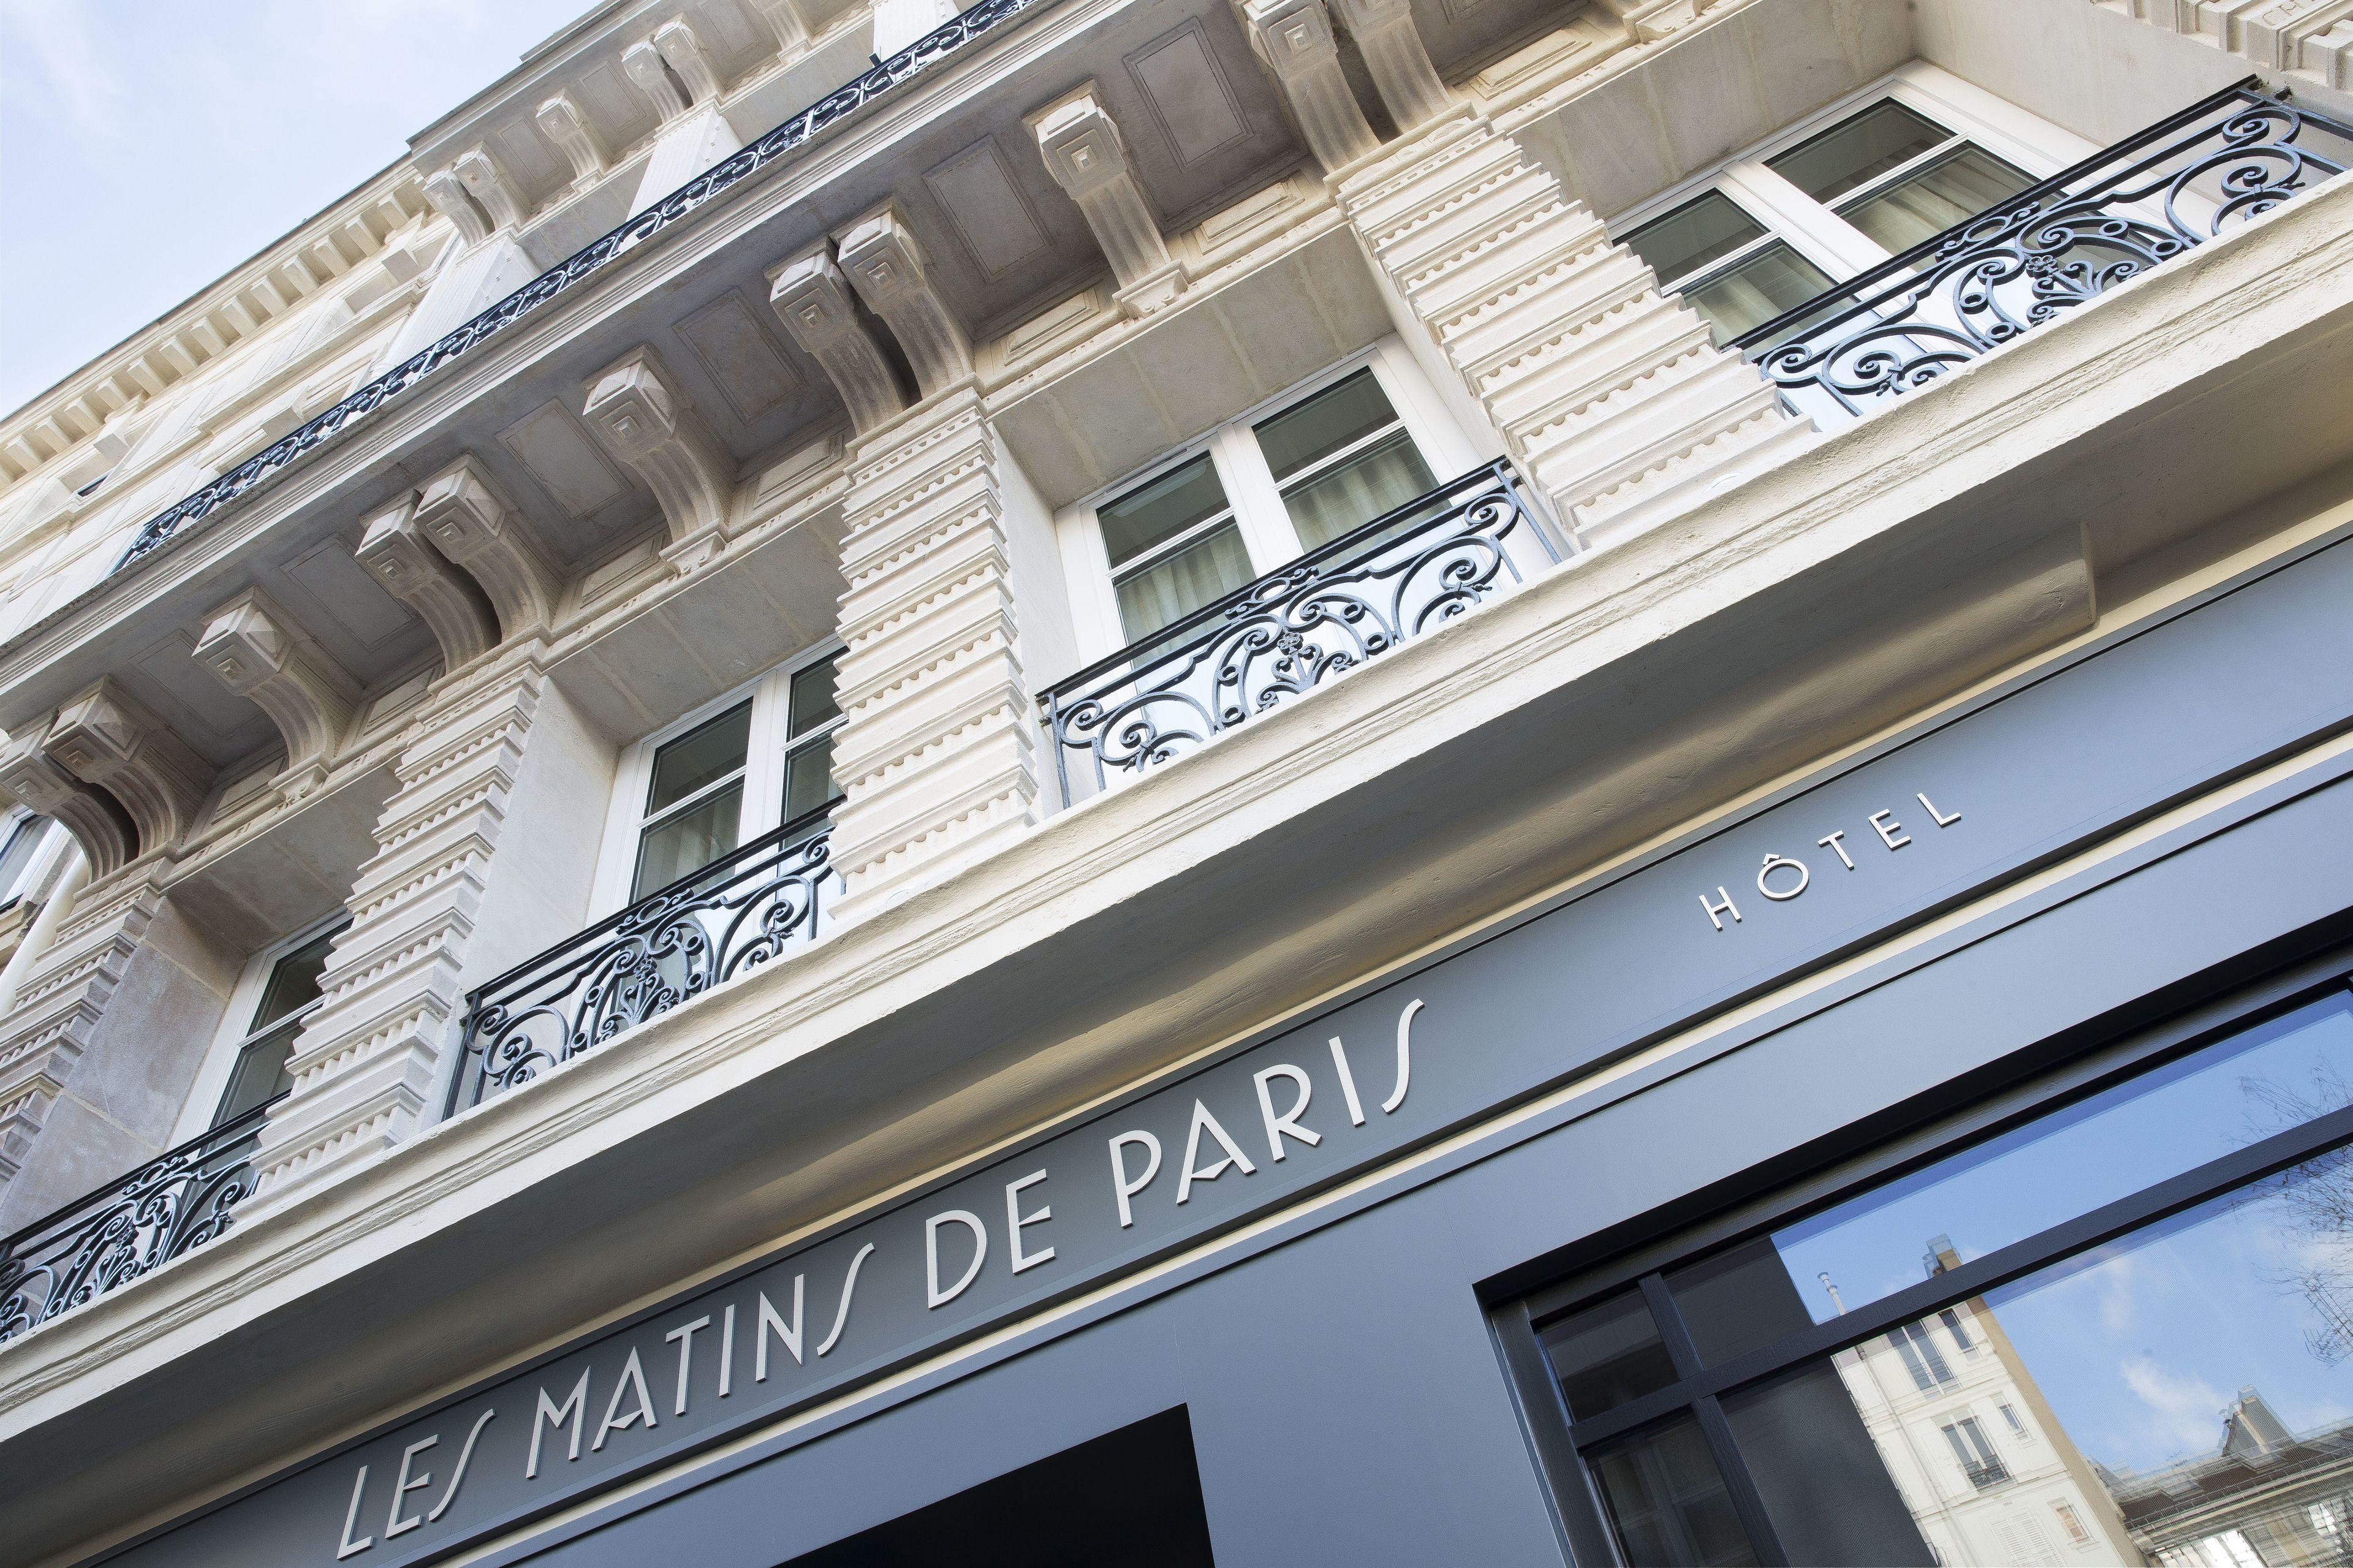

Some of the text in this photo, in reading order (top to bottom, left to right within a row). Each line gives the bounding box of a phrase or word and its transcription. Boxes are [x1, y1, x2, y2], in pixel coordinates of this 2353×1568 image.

[1699, 792, 1961, 931] HÔTEL
[336, 998, 1424, 1560] LES MATINS DE PARIS
